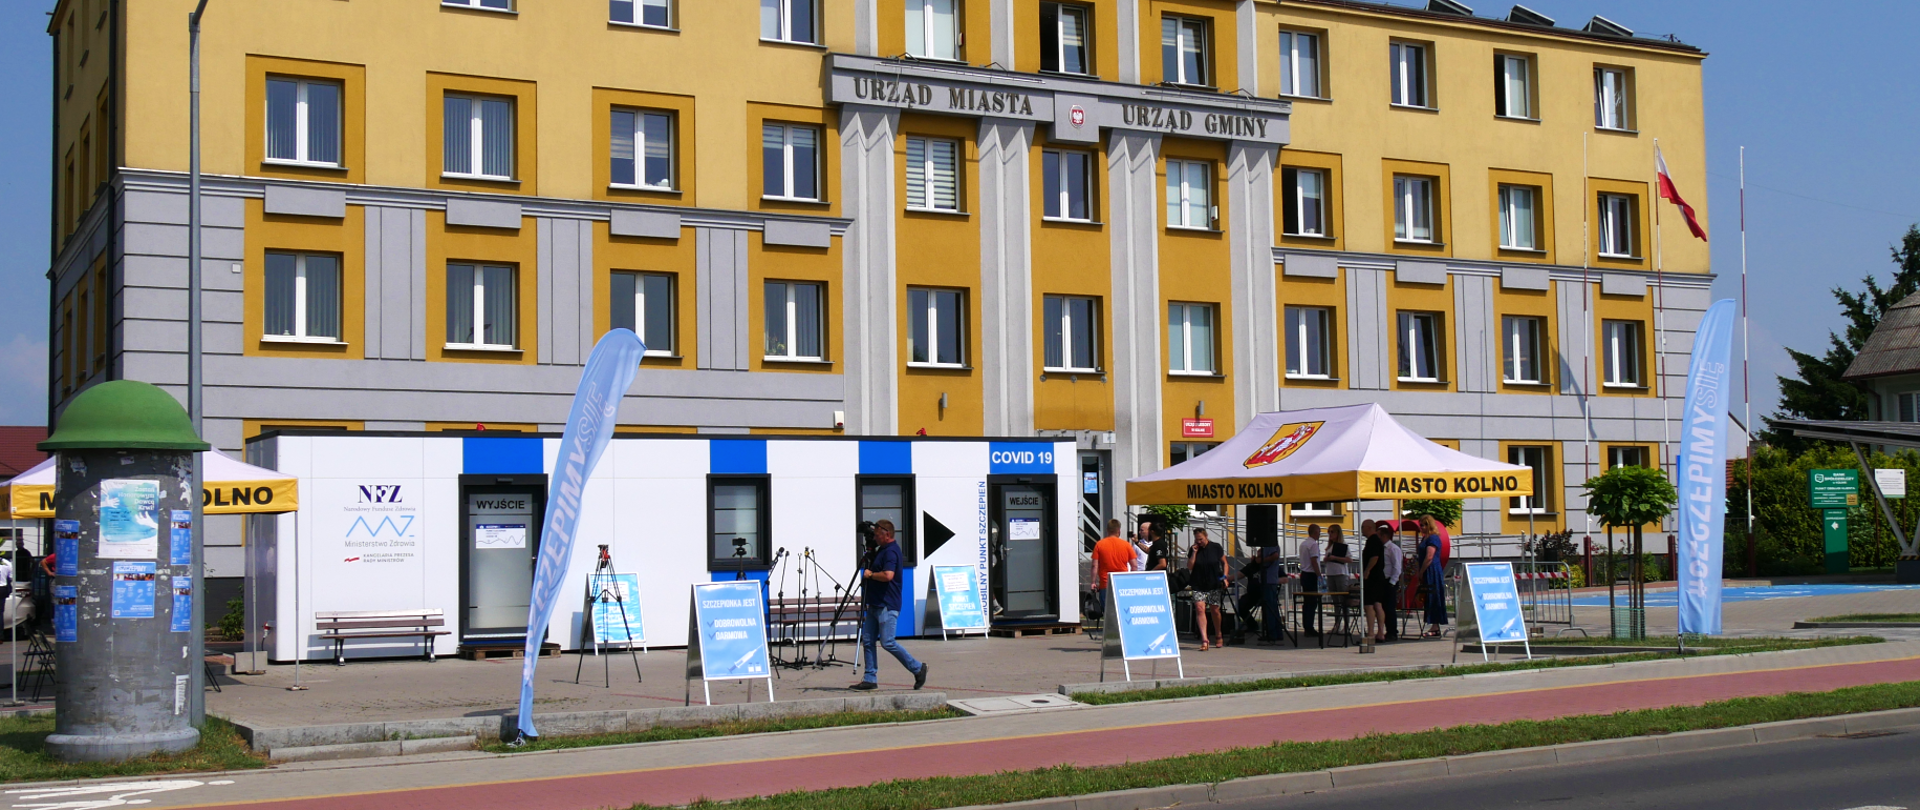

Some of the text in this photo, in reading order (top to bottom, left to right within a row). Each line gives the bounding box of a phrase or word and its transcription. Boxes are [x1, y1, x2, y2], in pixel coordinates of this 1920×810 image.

[853, 76, 1033, 115] URZĄD MIASTA
[1122, 104, 1268, 138] URZĄD GMINY
[991, 451, 1053, 464] COVID 19
[1374, 475, 1518, 493] MIASTO KOLNO
[357, 484, 403, 503] NFZ
[1187, 482, 1283, 499] MIASTO KOLNO
[476, 498, 525, 509] WYJŚCIE
[1009, 495, 1039, 506] WEJŚCIE
[977, 481, 986, 535] SZCZEPIEŃ
[345, 540, 388, 548] Ministerstwo
[979, 536, 987, 570] PUNKT
[1152, 587, 1164, 595] JEST
[702, 598, 756, 609] SZCZEPIONKA JEST
[952, 595, 969, 603] PUNKT
[948, 602, 976, 611] SZCZEPIEŃ
[1129, 605, 1166, 614] DOBROWOLNA
[714, 618, 757, 628] DOBROWOLNA
[715, 630, 748, 640] DARMOWA
